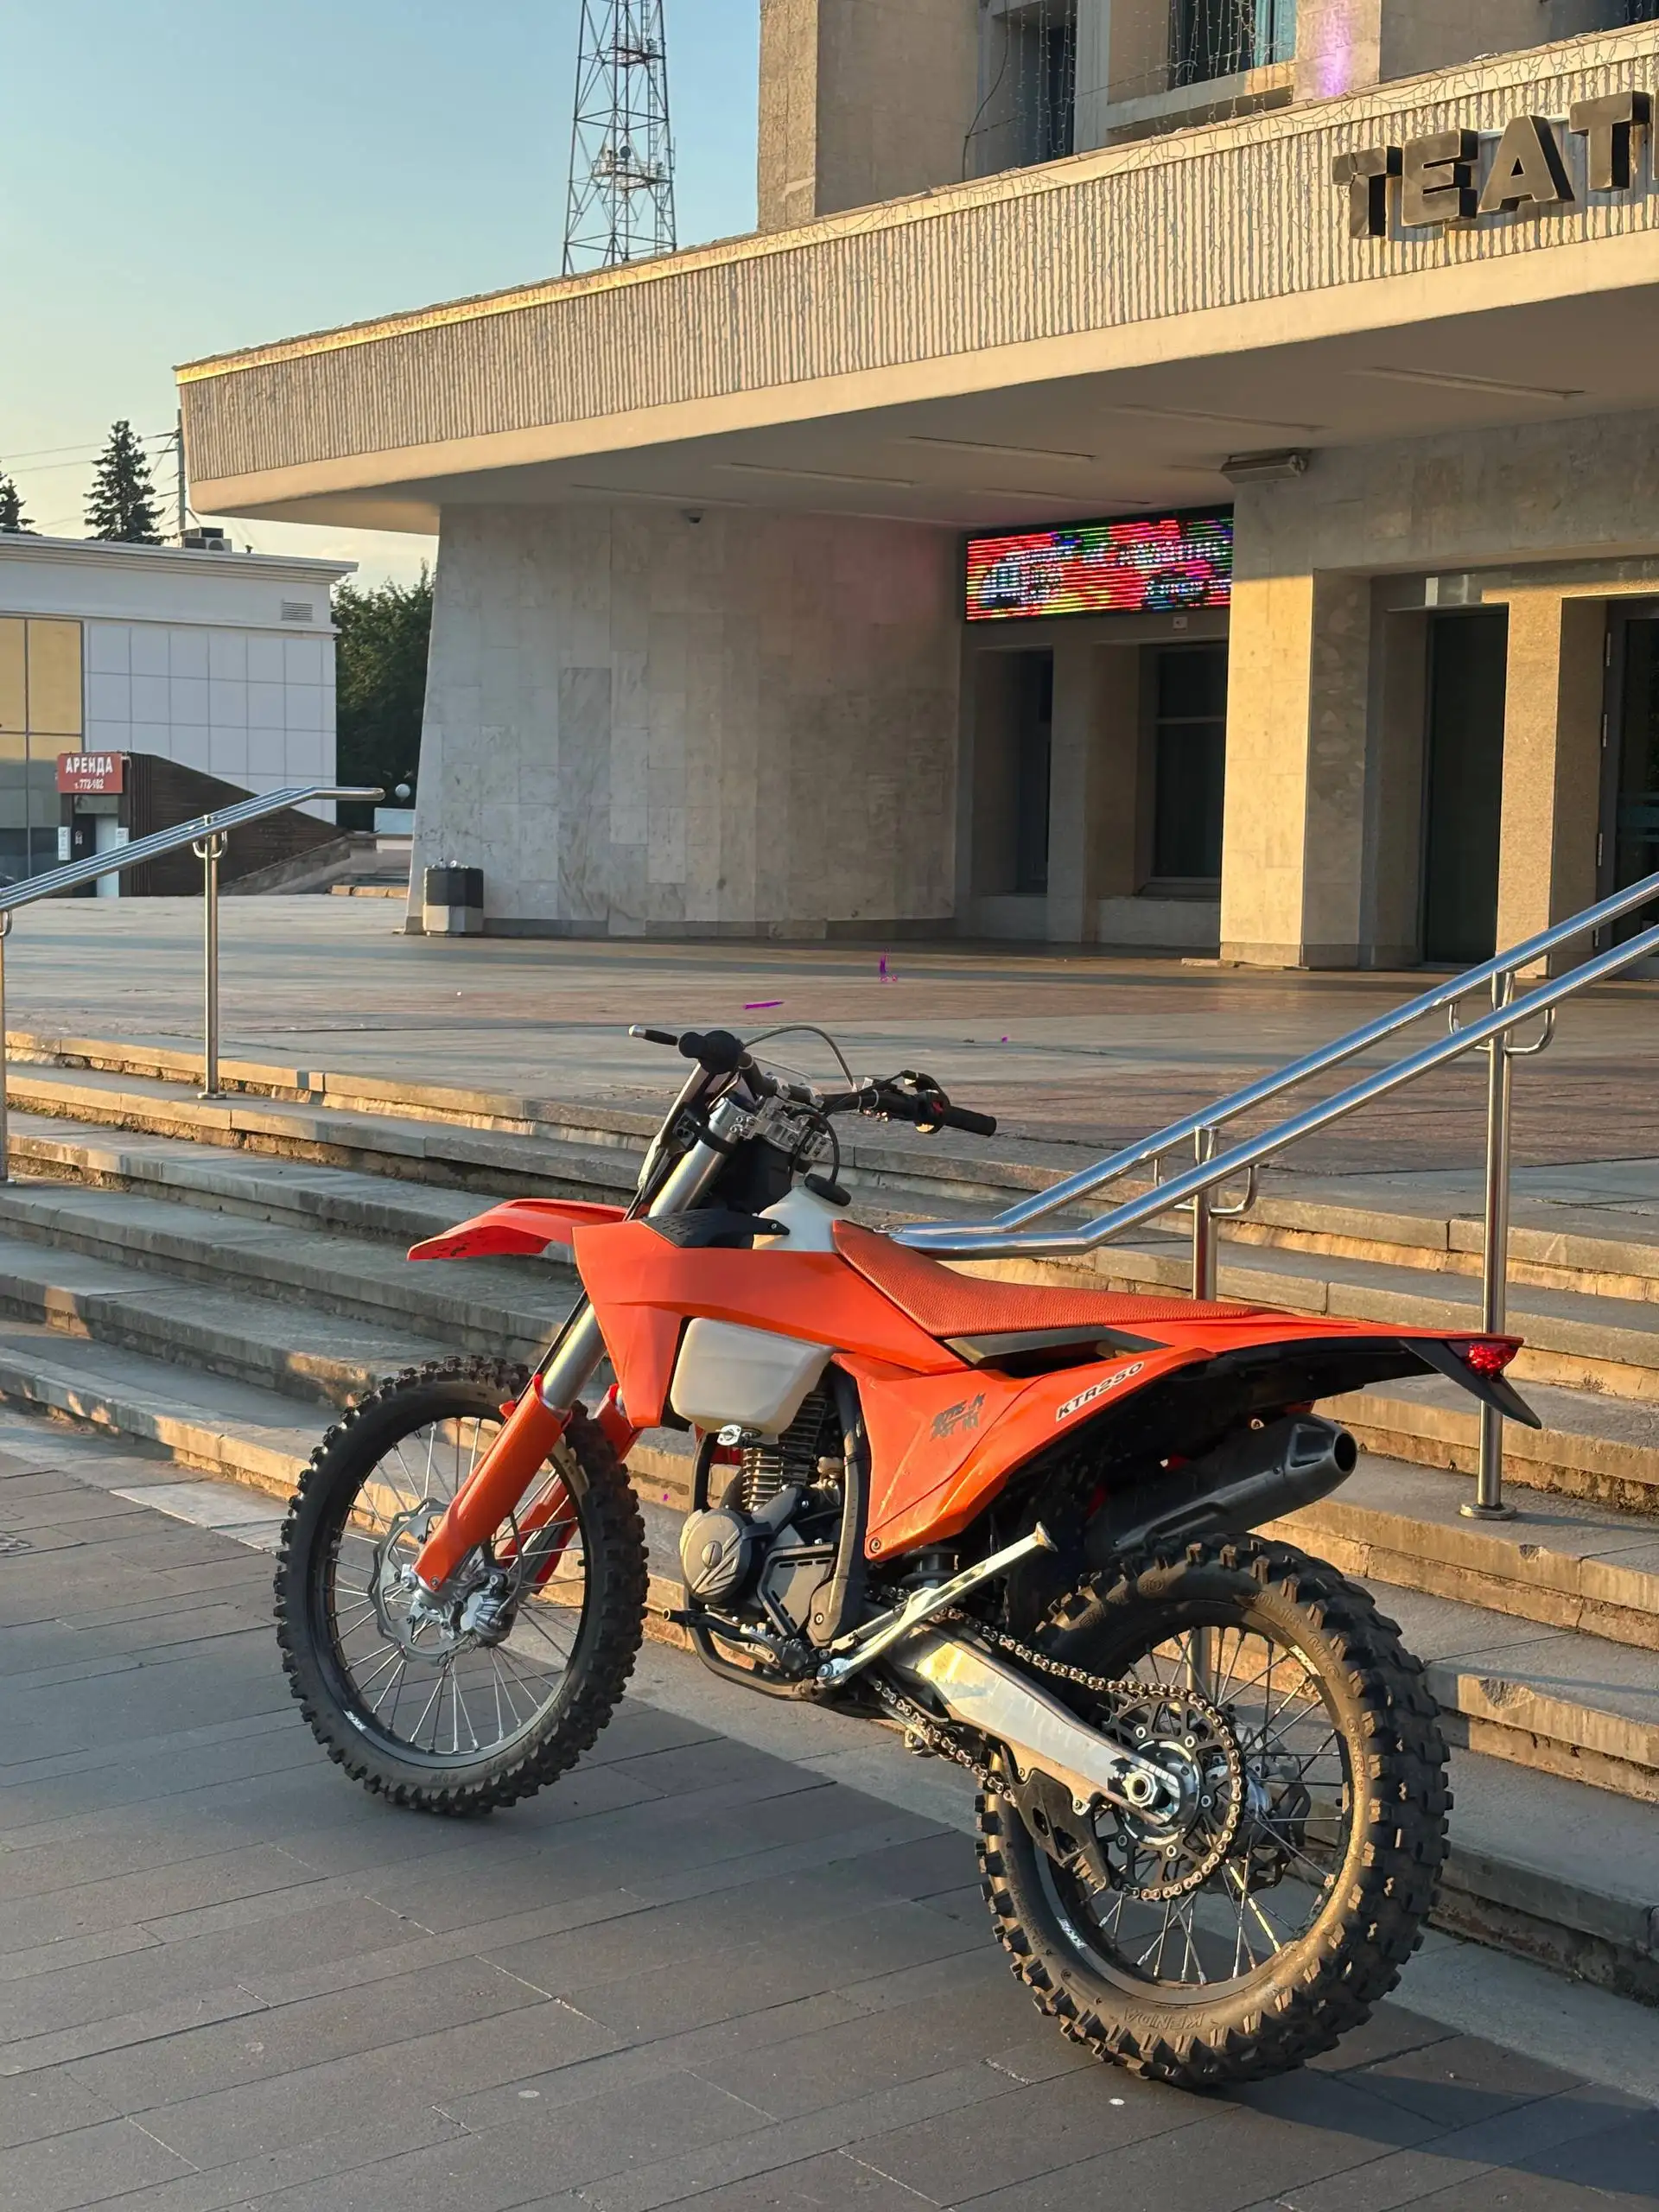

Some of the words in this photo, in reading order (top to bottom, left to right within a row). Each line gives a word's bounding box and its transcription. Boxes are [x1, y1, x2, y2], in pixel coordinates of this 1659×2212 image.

[1332, 90, 1659, 239] ТЕАТ
[65, 756, 113, 777] АРЕНДА
[1123, 2006, 1205, 2030] KENDA
